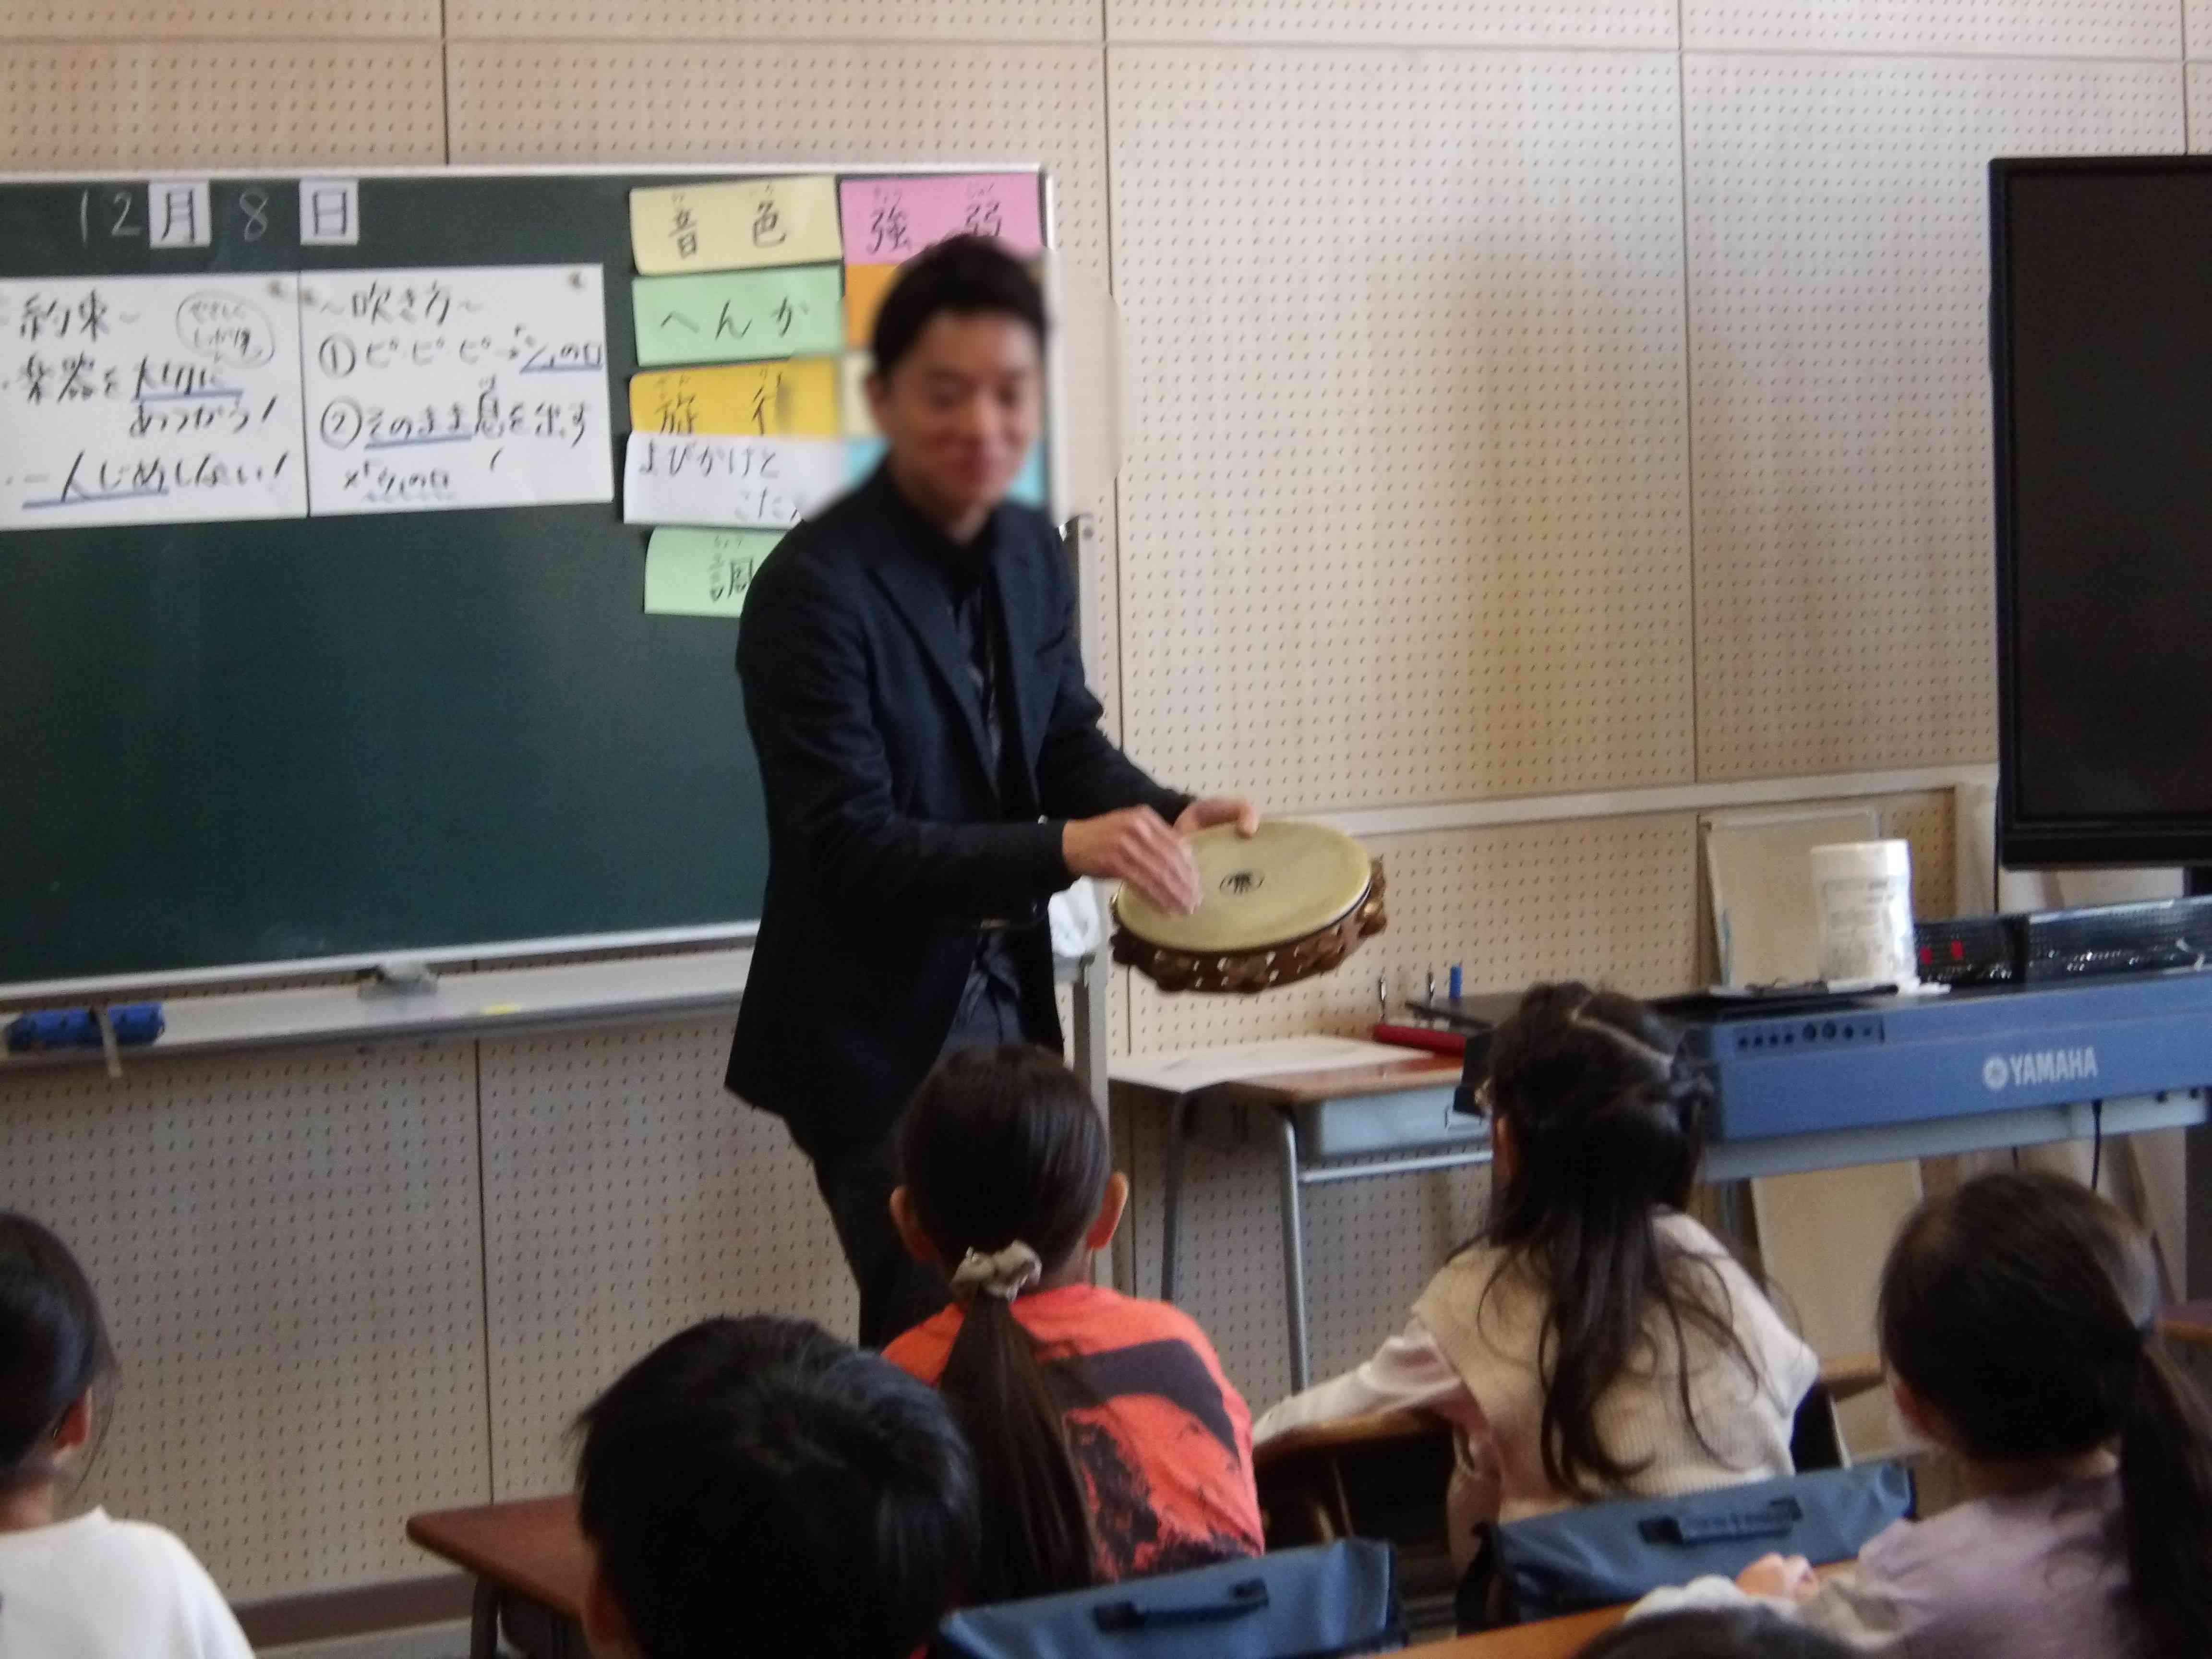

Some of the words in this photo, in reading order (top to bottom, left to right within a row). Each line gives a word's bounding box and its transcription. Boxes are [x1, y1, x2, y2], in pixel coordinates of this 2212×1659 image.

[658, 295, 810, 341] へんか
[640, 438, 781, 478] よびかけと
[2009, 1046, 2098, 1087] YAMAHA
